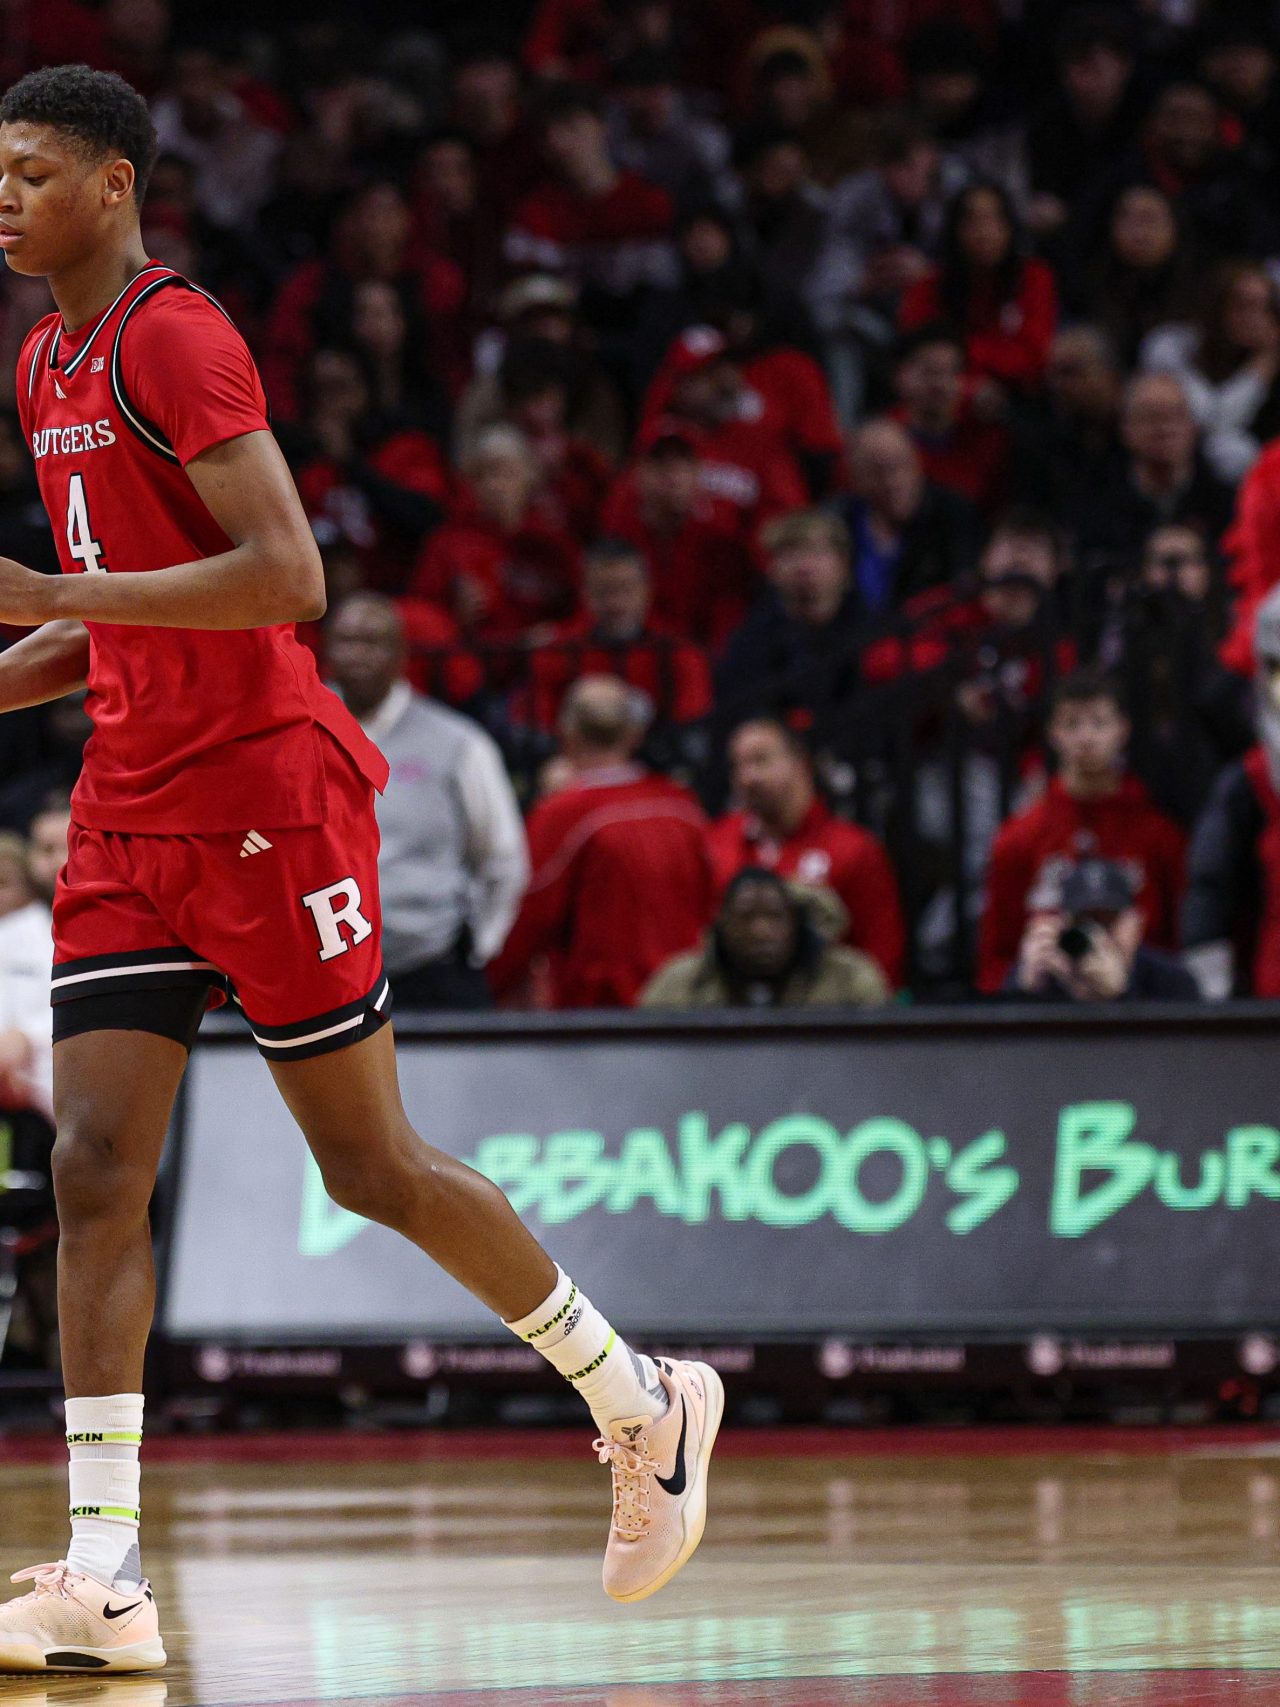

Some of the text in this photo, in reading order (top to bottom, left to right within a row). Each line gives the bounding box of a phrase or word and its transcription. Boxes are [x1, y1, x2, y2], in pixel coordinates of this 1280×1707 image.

[33, 419, 116, 459] RUTGERS
[67, 472, 107, 574] 4
[301, 876, 372, 962] R
[297, 1110, 1021, 1257] BBAKOO'S
[563, 1350, 608, 1381] ASKIN
[70, 1506, 101, 1516] KIN
